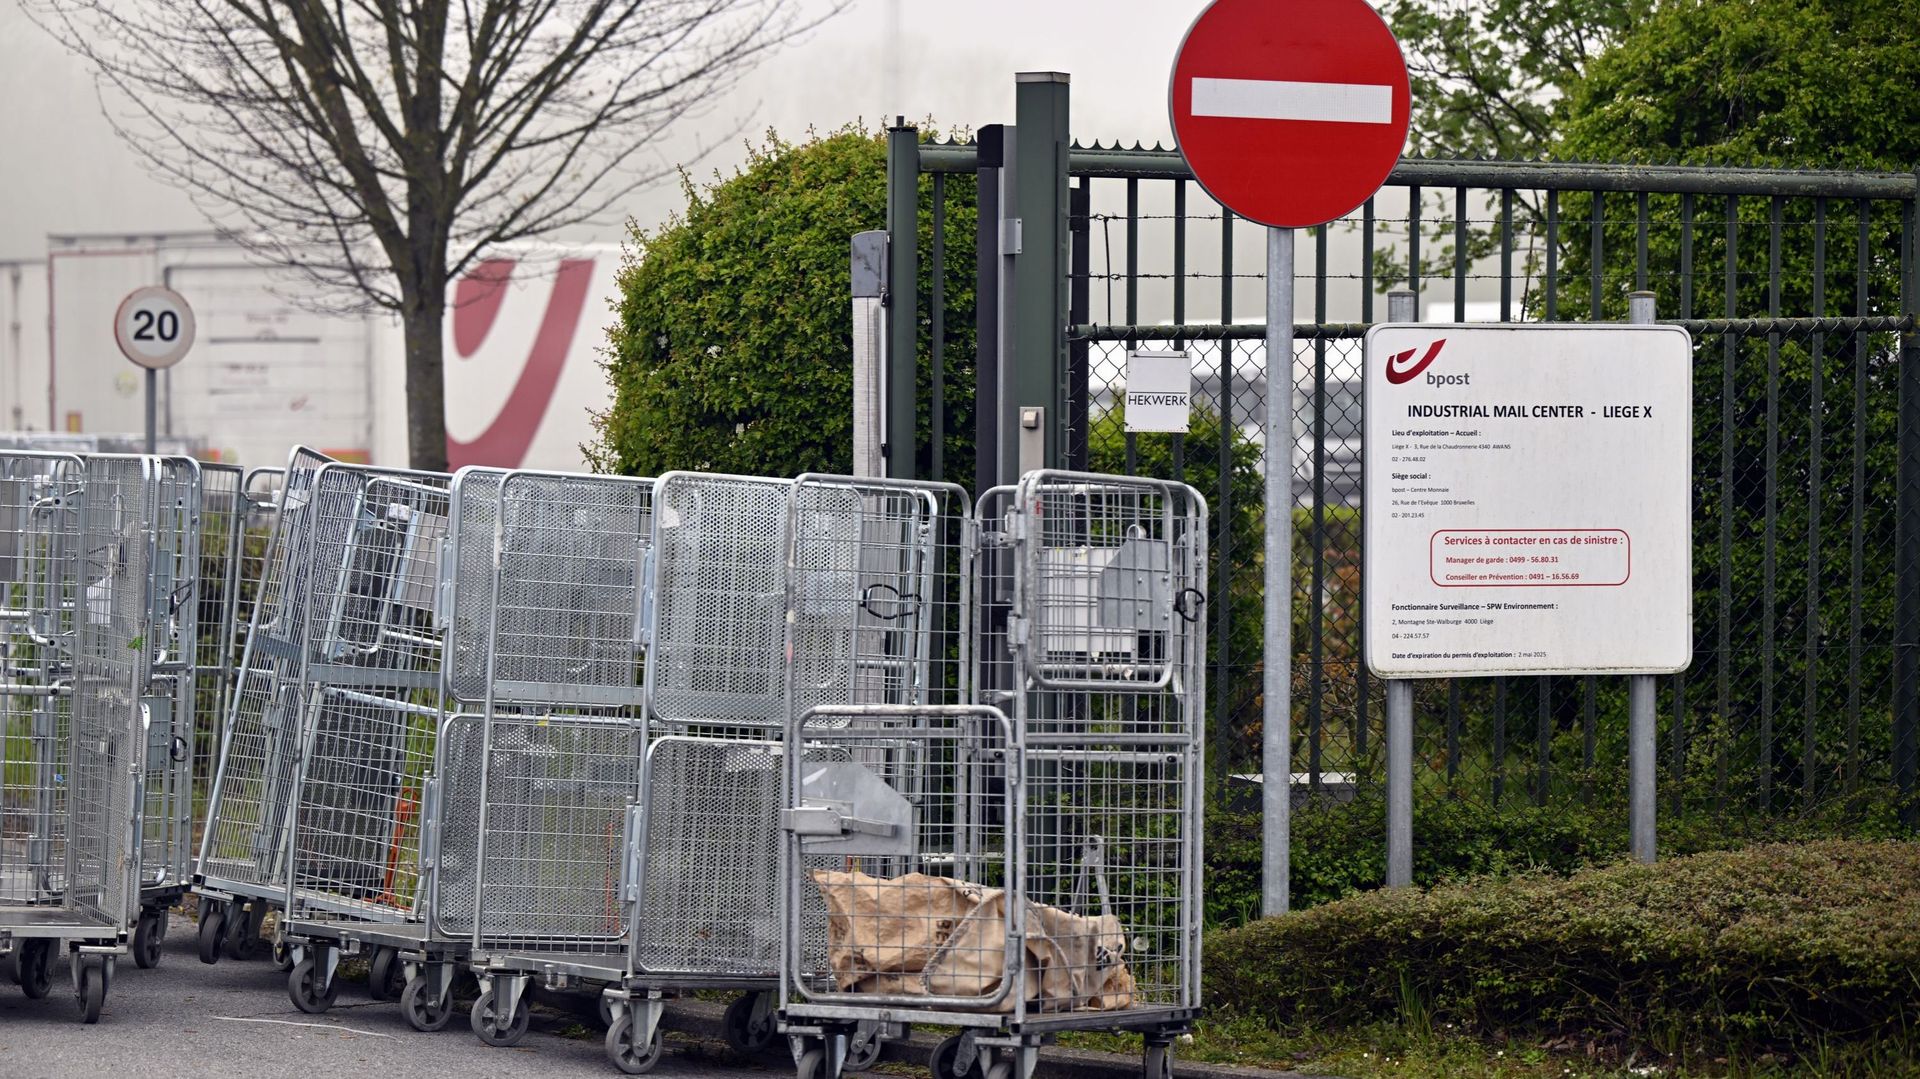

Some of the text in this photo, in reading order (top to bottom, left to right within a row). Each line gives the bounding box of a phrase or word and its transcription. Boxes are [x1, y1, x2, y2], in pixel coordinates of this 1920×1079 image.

[134, 310, 178, 341] 20
[1427, 372, 1469, 388] bpost
[1128, 395, 1187, 406] HEKWERK
[1409, 405, 1489, 417] INDUSTRIAL
[1494, 406, 1528, 417] MAIL
[1532, 406, 1583, 417] CENTER
[1604, 406, 1639, 418] LIEGE
[1644, 406, 1652, 418] X
[1445, 536, 1482, 545] Services
[1485, 536, 1490, 545] à
[1493, 536, 1537, 545] contacter
[1570, 536, 1582, 544] de
[1584, 536, 1617, 544] sinistre
